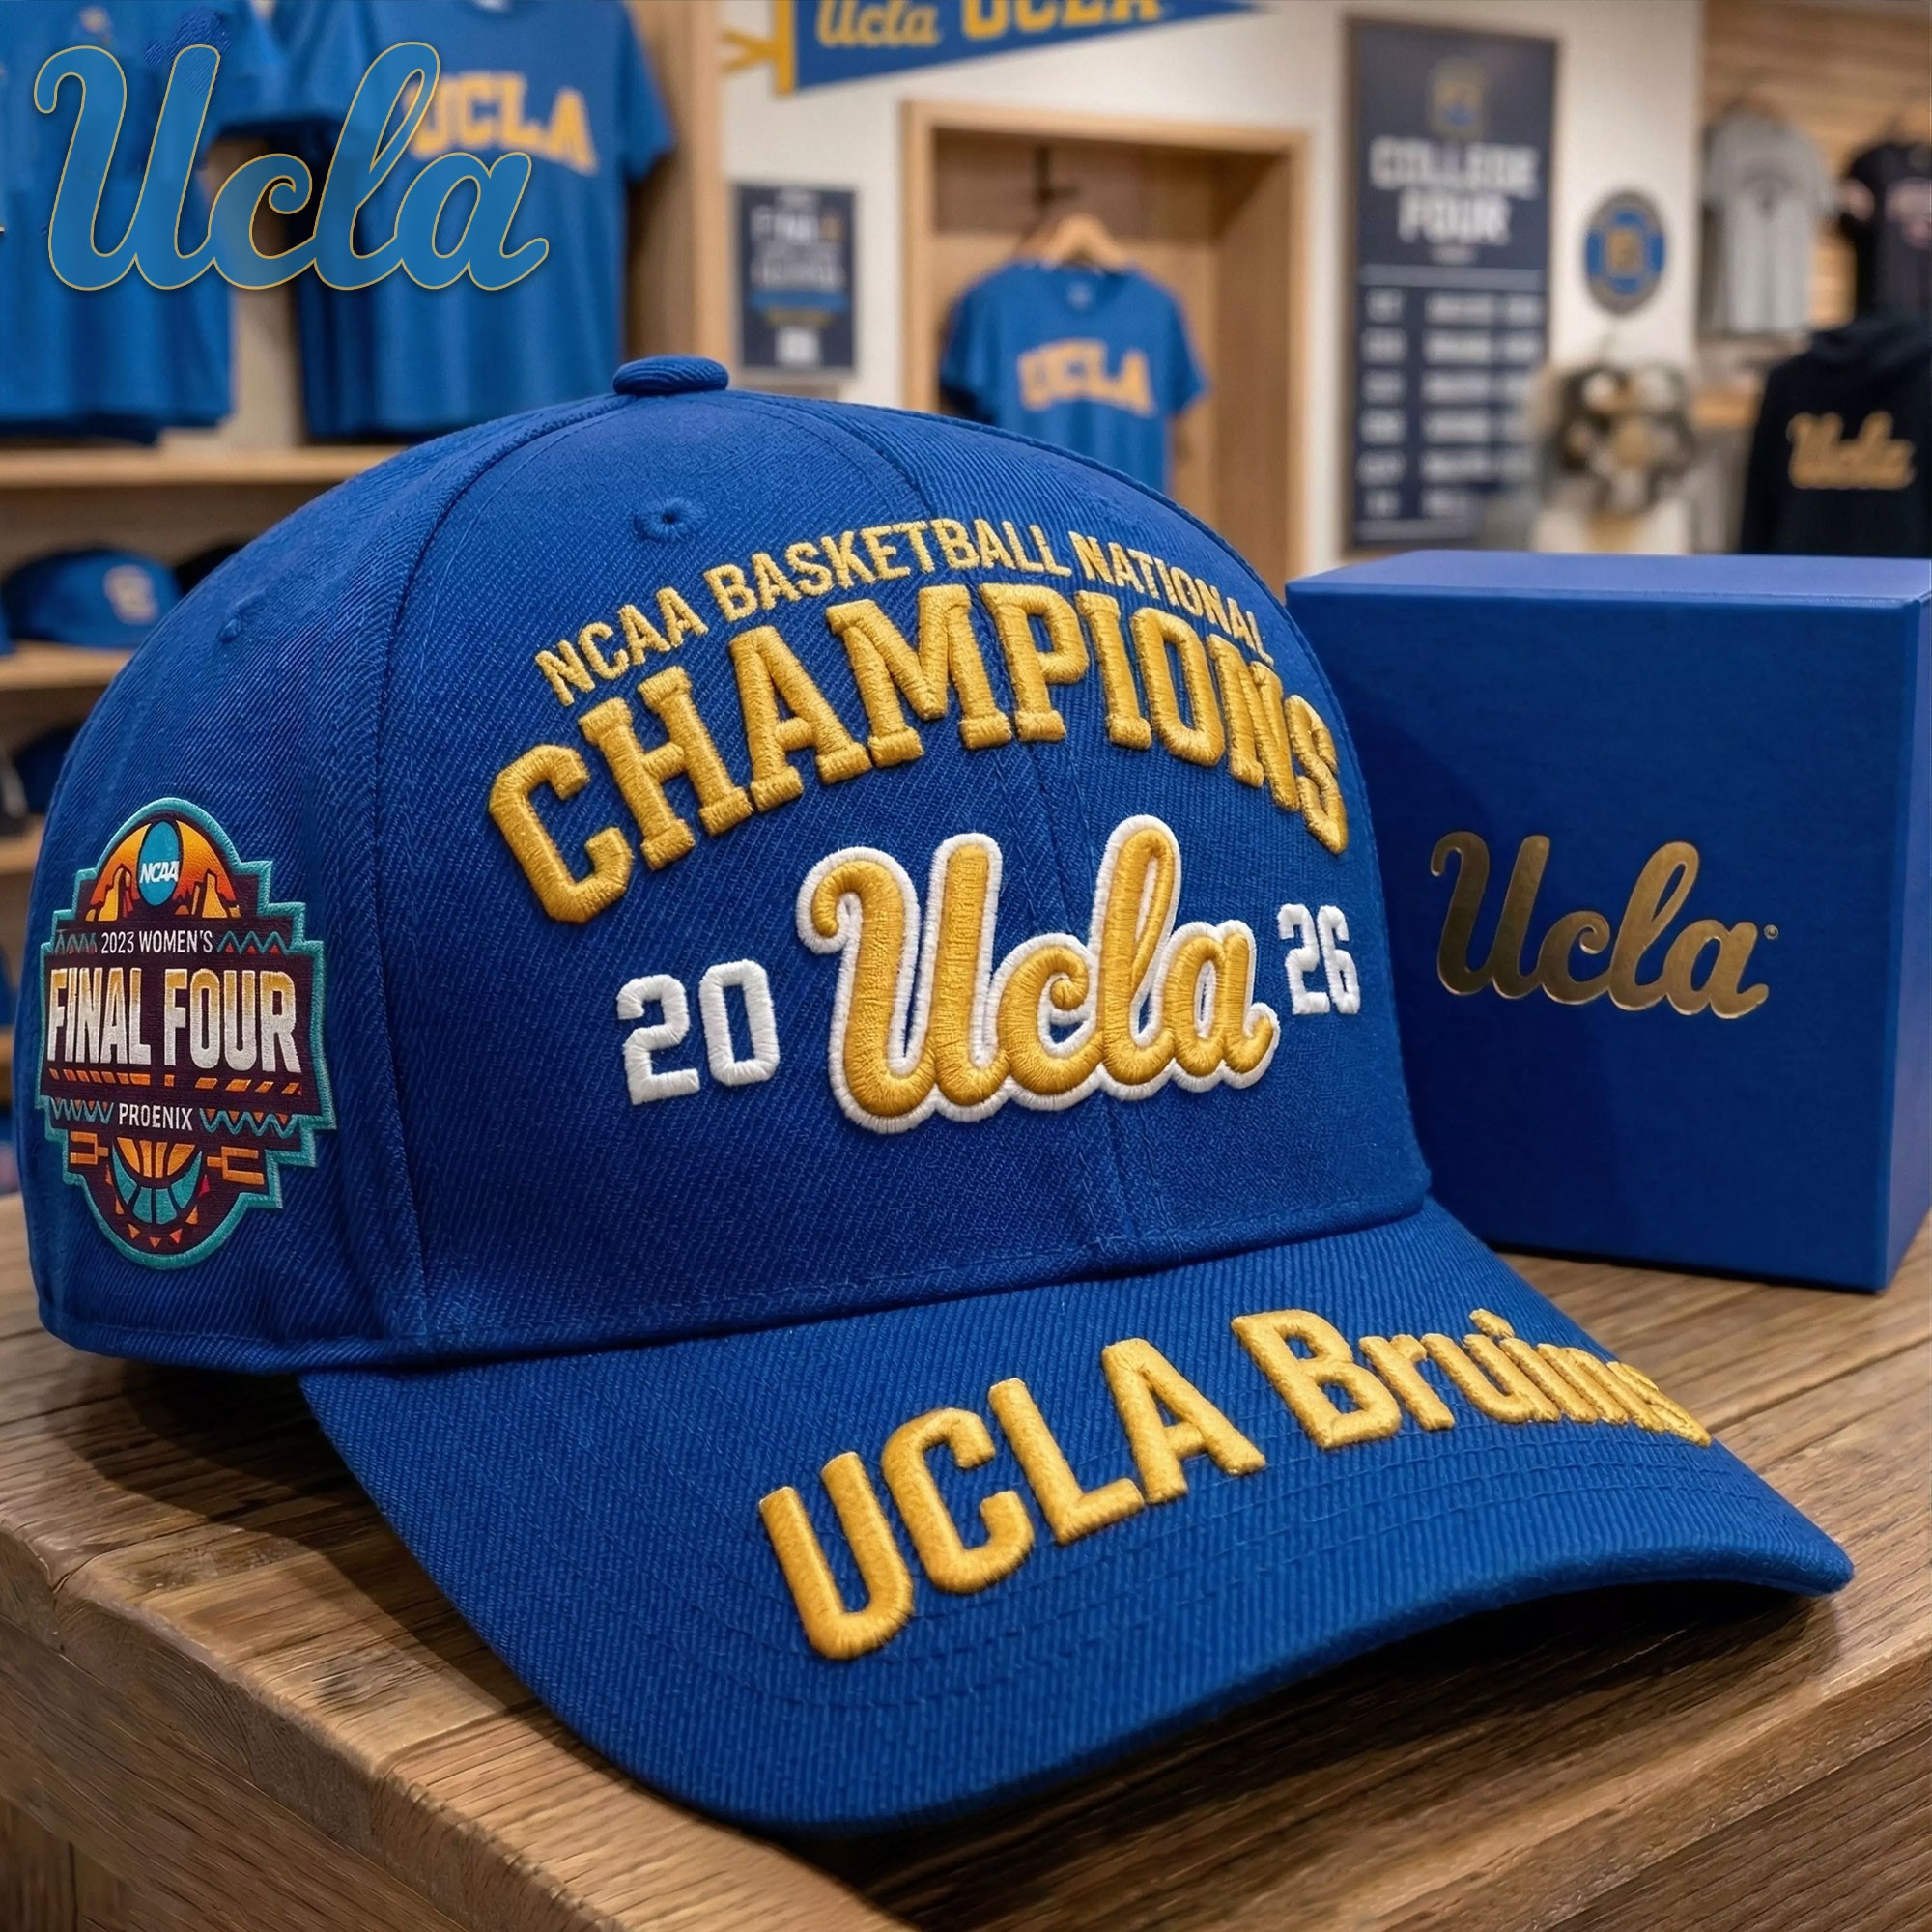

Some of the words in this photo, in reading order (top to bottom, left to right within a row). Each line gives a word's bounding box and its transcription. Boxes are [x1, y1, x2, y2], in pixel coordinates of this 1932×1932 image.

[534, 588, 709, 706] NCAA
[703, 518, 1071, 621] BASKETBALL
[1069, 530, 1274, 664] NATIONAL
[489, 583, 1349, 923] CHAMPIONS
[100, 930, 135, 954] 2023
[138, 929, 213, 954] WOMEN'S
[139, 861, 180, 885] NCAA
[1430, 830, 1770, 1020] Ucla
[46, 967, 152, 1066] FINAL
[163, 967, 302, 1073] FOUR
[616, 959, 781, 1105] 20
[796, 813, 1282, 1134] Ucla
[1277, 903, 1361, 1015] 26
[118, 1102, 194, 1131] PROENIX
[758, 1336, 1267, 1661] UCLA
[1230, 1308, 1713, 1449] Bruins
